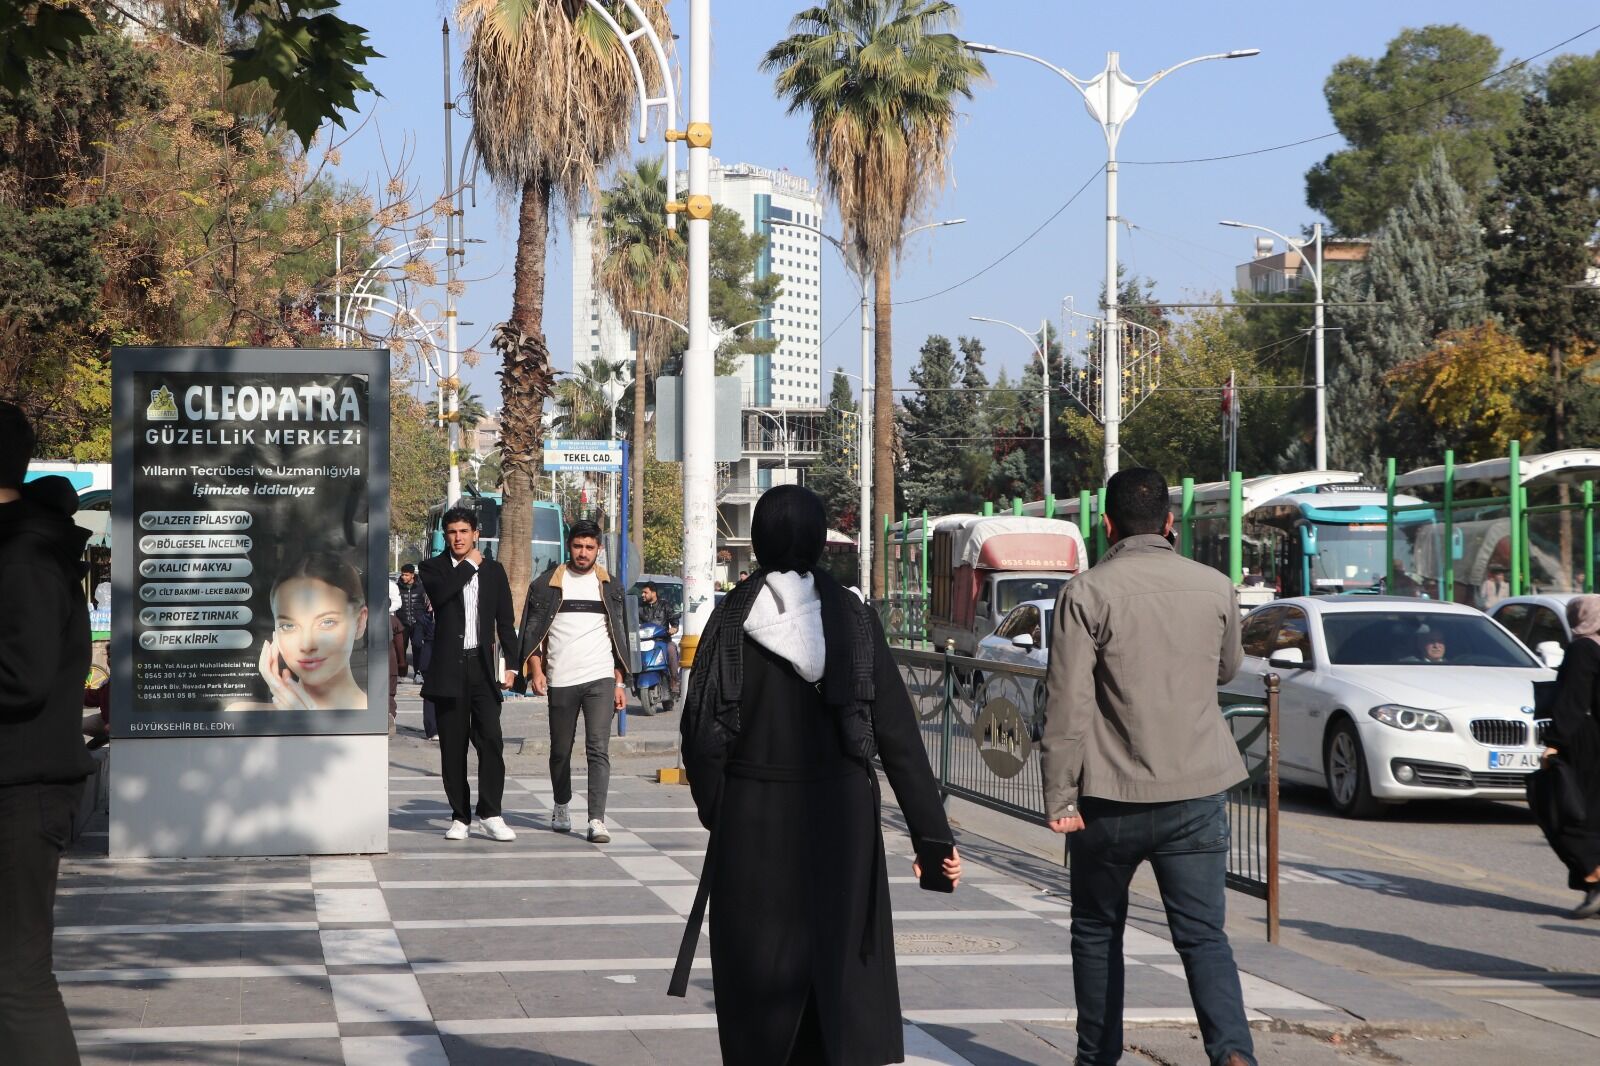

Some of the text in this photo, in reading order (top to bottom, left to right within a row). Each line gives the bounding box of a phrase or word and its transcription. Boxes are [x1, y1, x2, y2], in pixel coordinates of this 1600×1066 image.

[184, 385, 361, 422] CLEOPATRA
[564, 453, 613, 463] TEKEL CAD.
[142, 465, 361, 479] Yılların Tecrübesi ve Uzmanlığıyla
[192, 482, 316, 498] İşimizde İddialıyız
[157, 513, 250, 525] LAZER EPİLASYON
[156, 538, 250, 549] BÖLGESEL İNCELME
[158, 562, 232, 573] KALICI MAKYAJ
[159, 587, 173, 596] CİLT
[174, 588, 200, 596] BAKIMI
[224, 587, 249, 595] BAKIMI
[158, 610, 240, 621] PROTEZ TIRNAK
[159, 632, 219, 645] İPEK KİRPİK
[1498, 753, 1515, 767] 07
